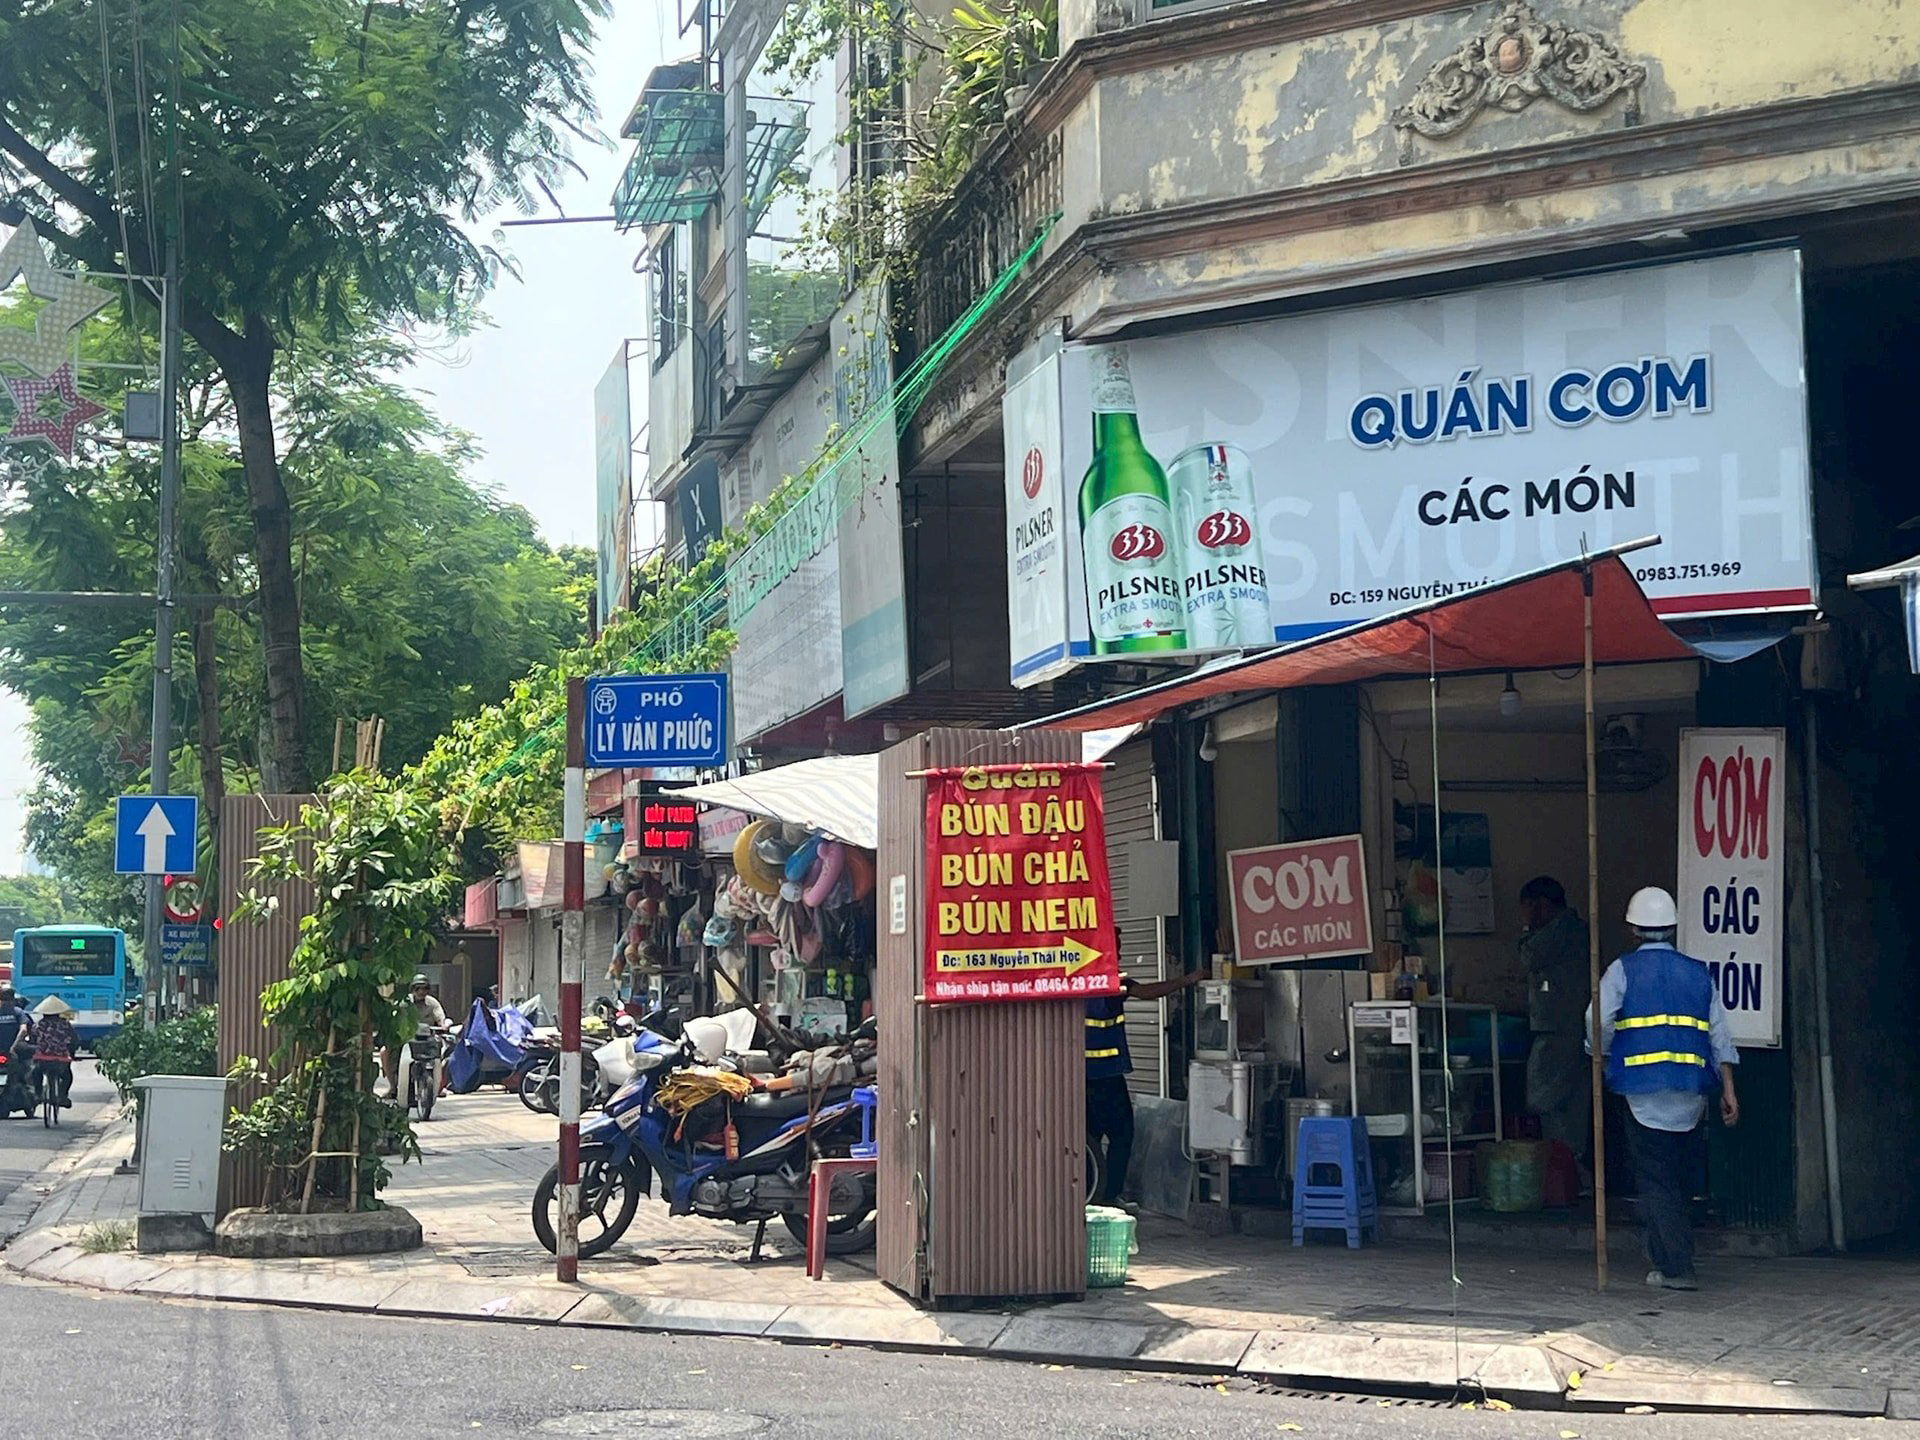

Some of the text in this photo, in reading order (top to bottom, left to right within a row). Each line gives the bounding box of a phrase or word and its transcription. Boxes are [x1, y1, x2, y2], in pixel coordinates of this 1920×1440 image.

[1349, 356, 1709, 447] QUÁN CƠM
[1418, 465, 1635, 526] CÁC MÓN
[1016, 507, 1054, 553] PILSNER
[1120, 523, 1156, 558] 333
[1206, 509, 1242, 544] 333
[1185, 565, 1267, 598] PILSNER
[1637, 562, 1741, 581] 0983.751.969
[1098, 576, 1180, 609] PILSNER
[1187, 589, 1225, 614] EXTRA
[1330, 592, 1356, 605] ĐC:
[1360, 589, 1383, 602] 159
[1101, 602, 1137, 625] EXTRA
[641, 685, 684, 707] PHỐ
[597, 713, 712, 752] LÝ VĂN PHỨC
[941, 795, 1085, 841] BÚN ĐẬU
[1694, 745, 1771, 859] CƠM
[942, 839, 1089, 887] BÚN CHẢ
[1242, 854, 1354, 914] CƠM
[939, 894, 1011, 935] BÚN
[1021, 897, 1098, 933] NEM
[1703, 876, 1760, 935] CÁC
[1254, 916, 1352, 950] CÁC MÓN
[943, 954, 961, 967] Đc:
[966, 954, 985, 967] 163
[990, 951, 1029, 968] Nguyễn
[1060, 951, 1080, 964] Học
[967, 980, 989, 997] ship
[1035, 977, 1067, 993] 08464
[1071, 976, 1085, 991] 29
[1088, 974, 1109, 990] 222
